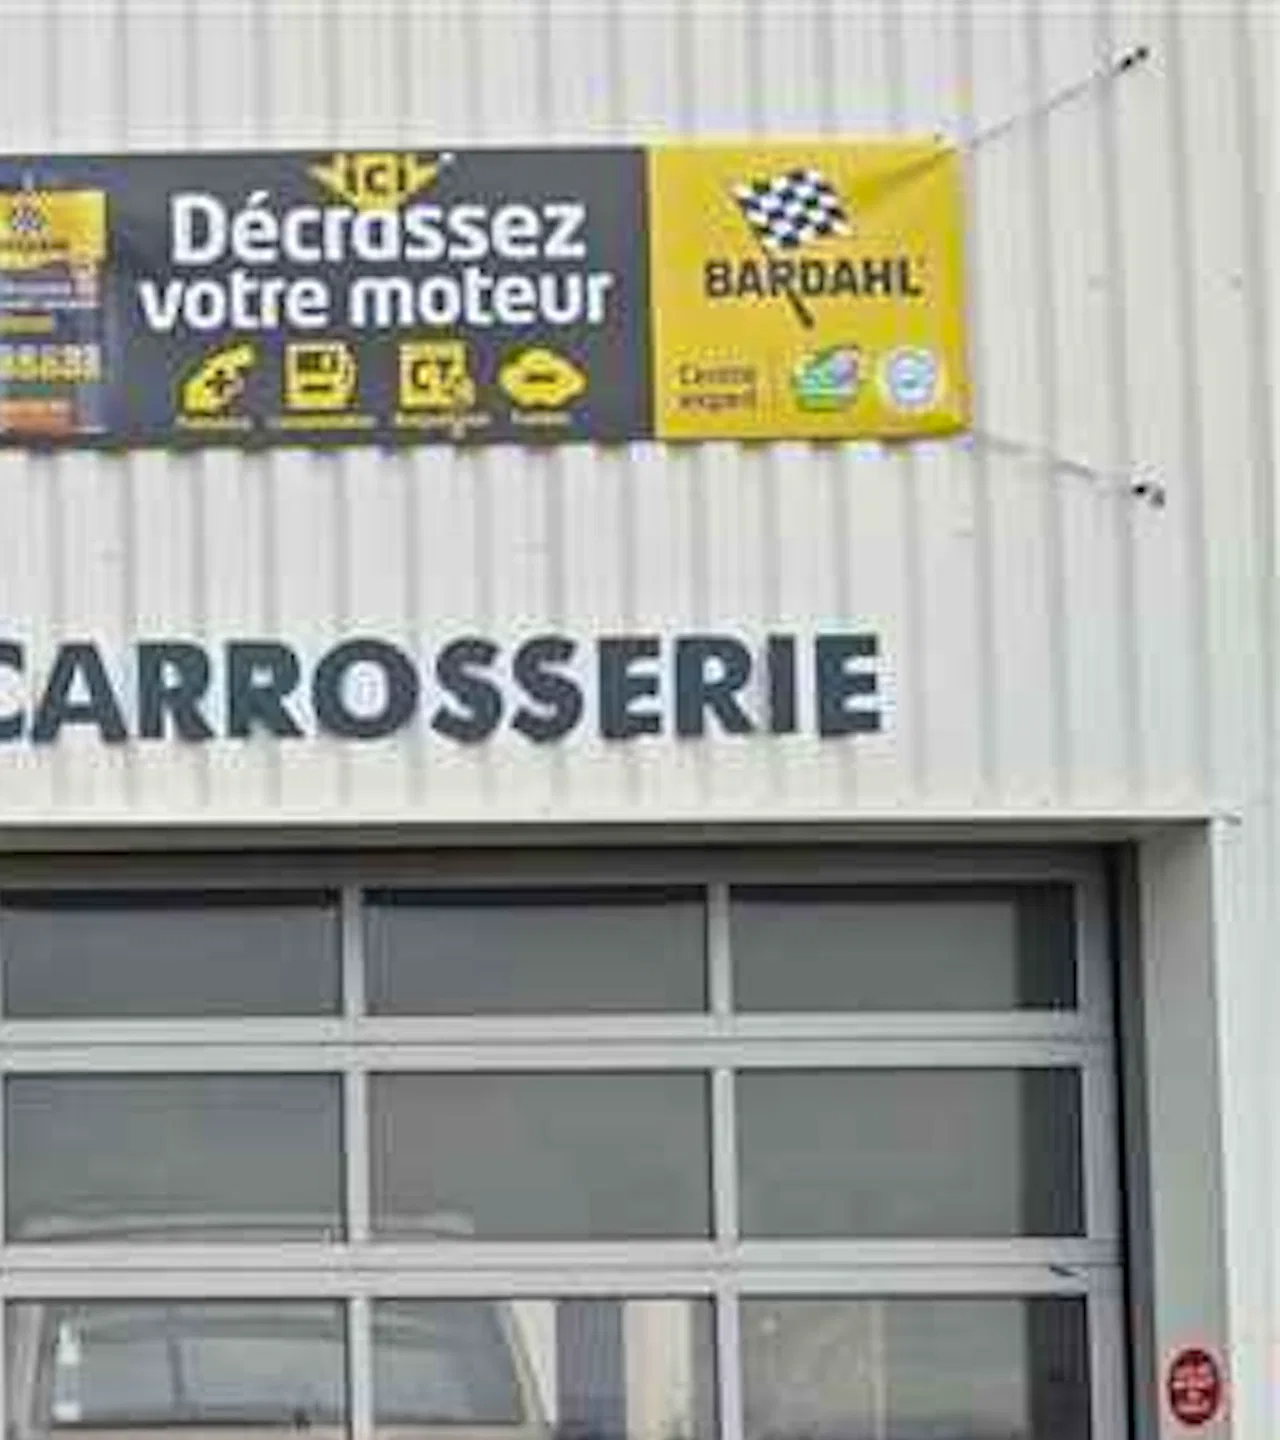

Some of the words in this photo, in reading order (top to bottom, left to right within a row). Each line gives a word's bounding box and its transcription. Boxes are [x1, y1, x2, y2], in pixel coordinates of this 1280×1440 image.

[169, 192, 587, 264] Décrassez
[140, 266, 329, 331] votre
[348, 266, 616, 326] moteur
[704, 256, 924, 299] BARDAHL
